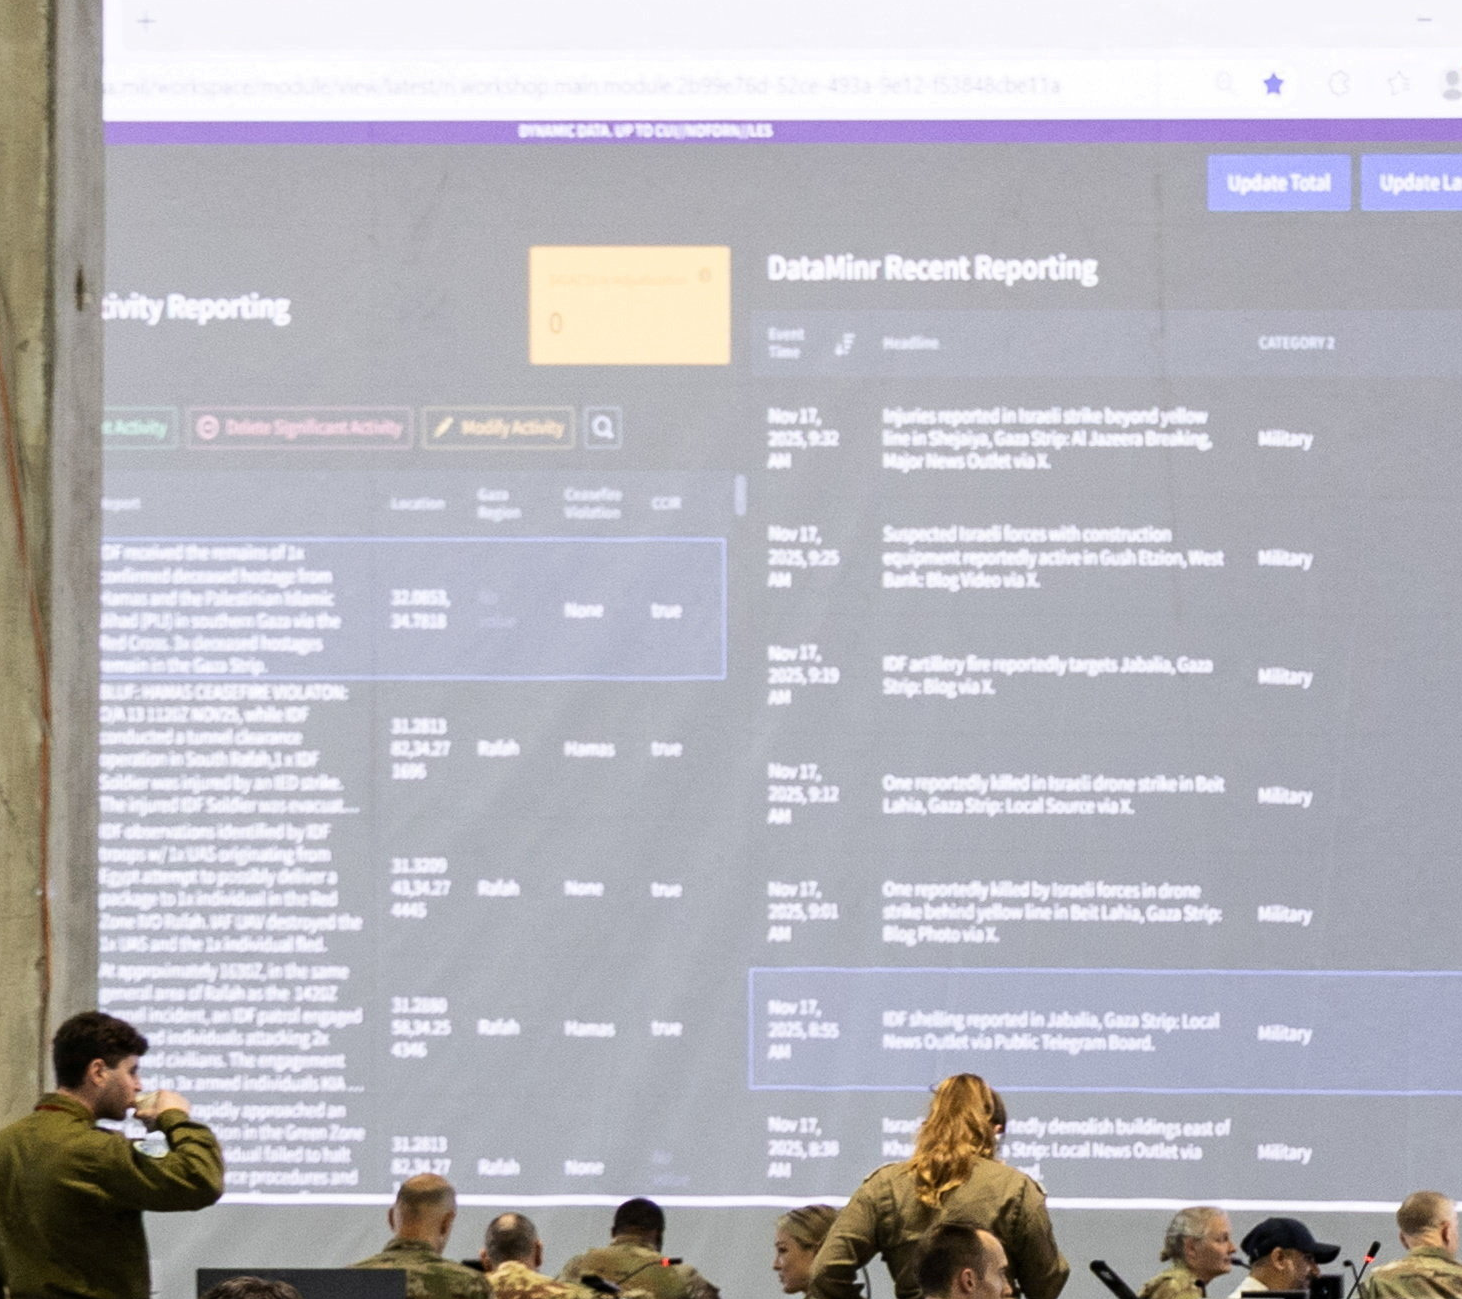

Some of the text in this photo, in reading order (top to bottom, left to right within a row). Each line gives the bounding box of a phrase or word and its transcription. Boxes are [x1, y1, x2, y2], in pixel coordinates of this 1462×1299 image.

[1226, 172, 1332, 196] Update Total
[1379, 172, 1441, 196] Update
[767, 252, 1099, 288] DataMinr Recent Reporting
[103, 291, 165, 326] tivity
[1257, 429, 1314, 451] Military
[1257, 548, 1314, 571] Military
[1257, 667, 1314, 690] Military
[1257, 786, 1314, 809] Military
[1257, 904, 1313, 927] Military
[882, 1010, 908, 1028] IDF
[882, 1033, 1156, 1056] News Outlet via Public Telegram Board.
[1257, 1024, 1313, 1046] Military
[1257, 1143, 1313, 1165] Military
